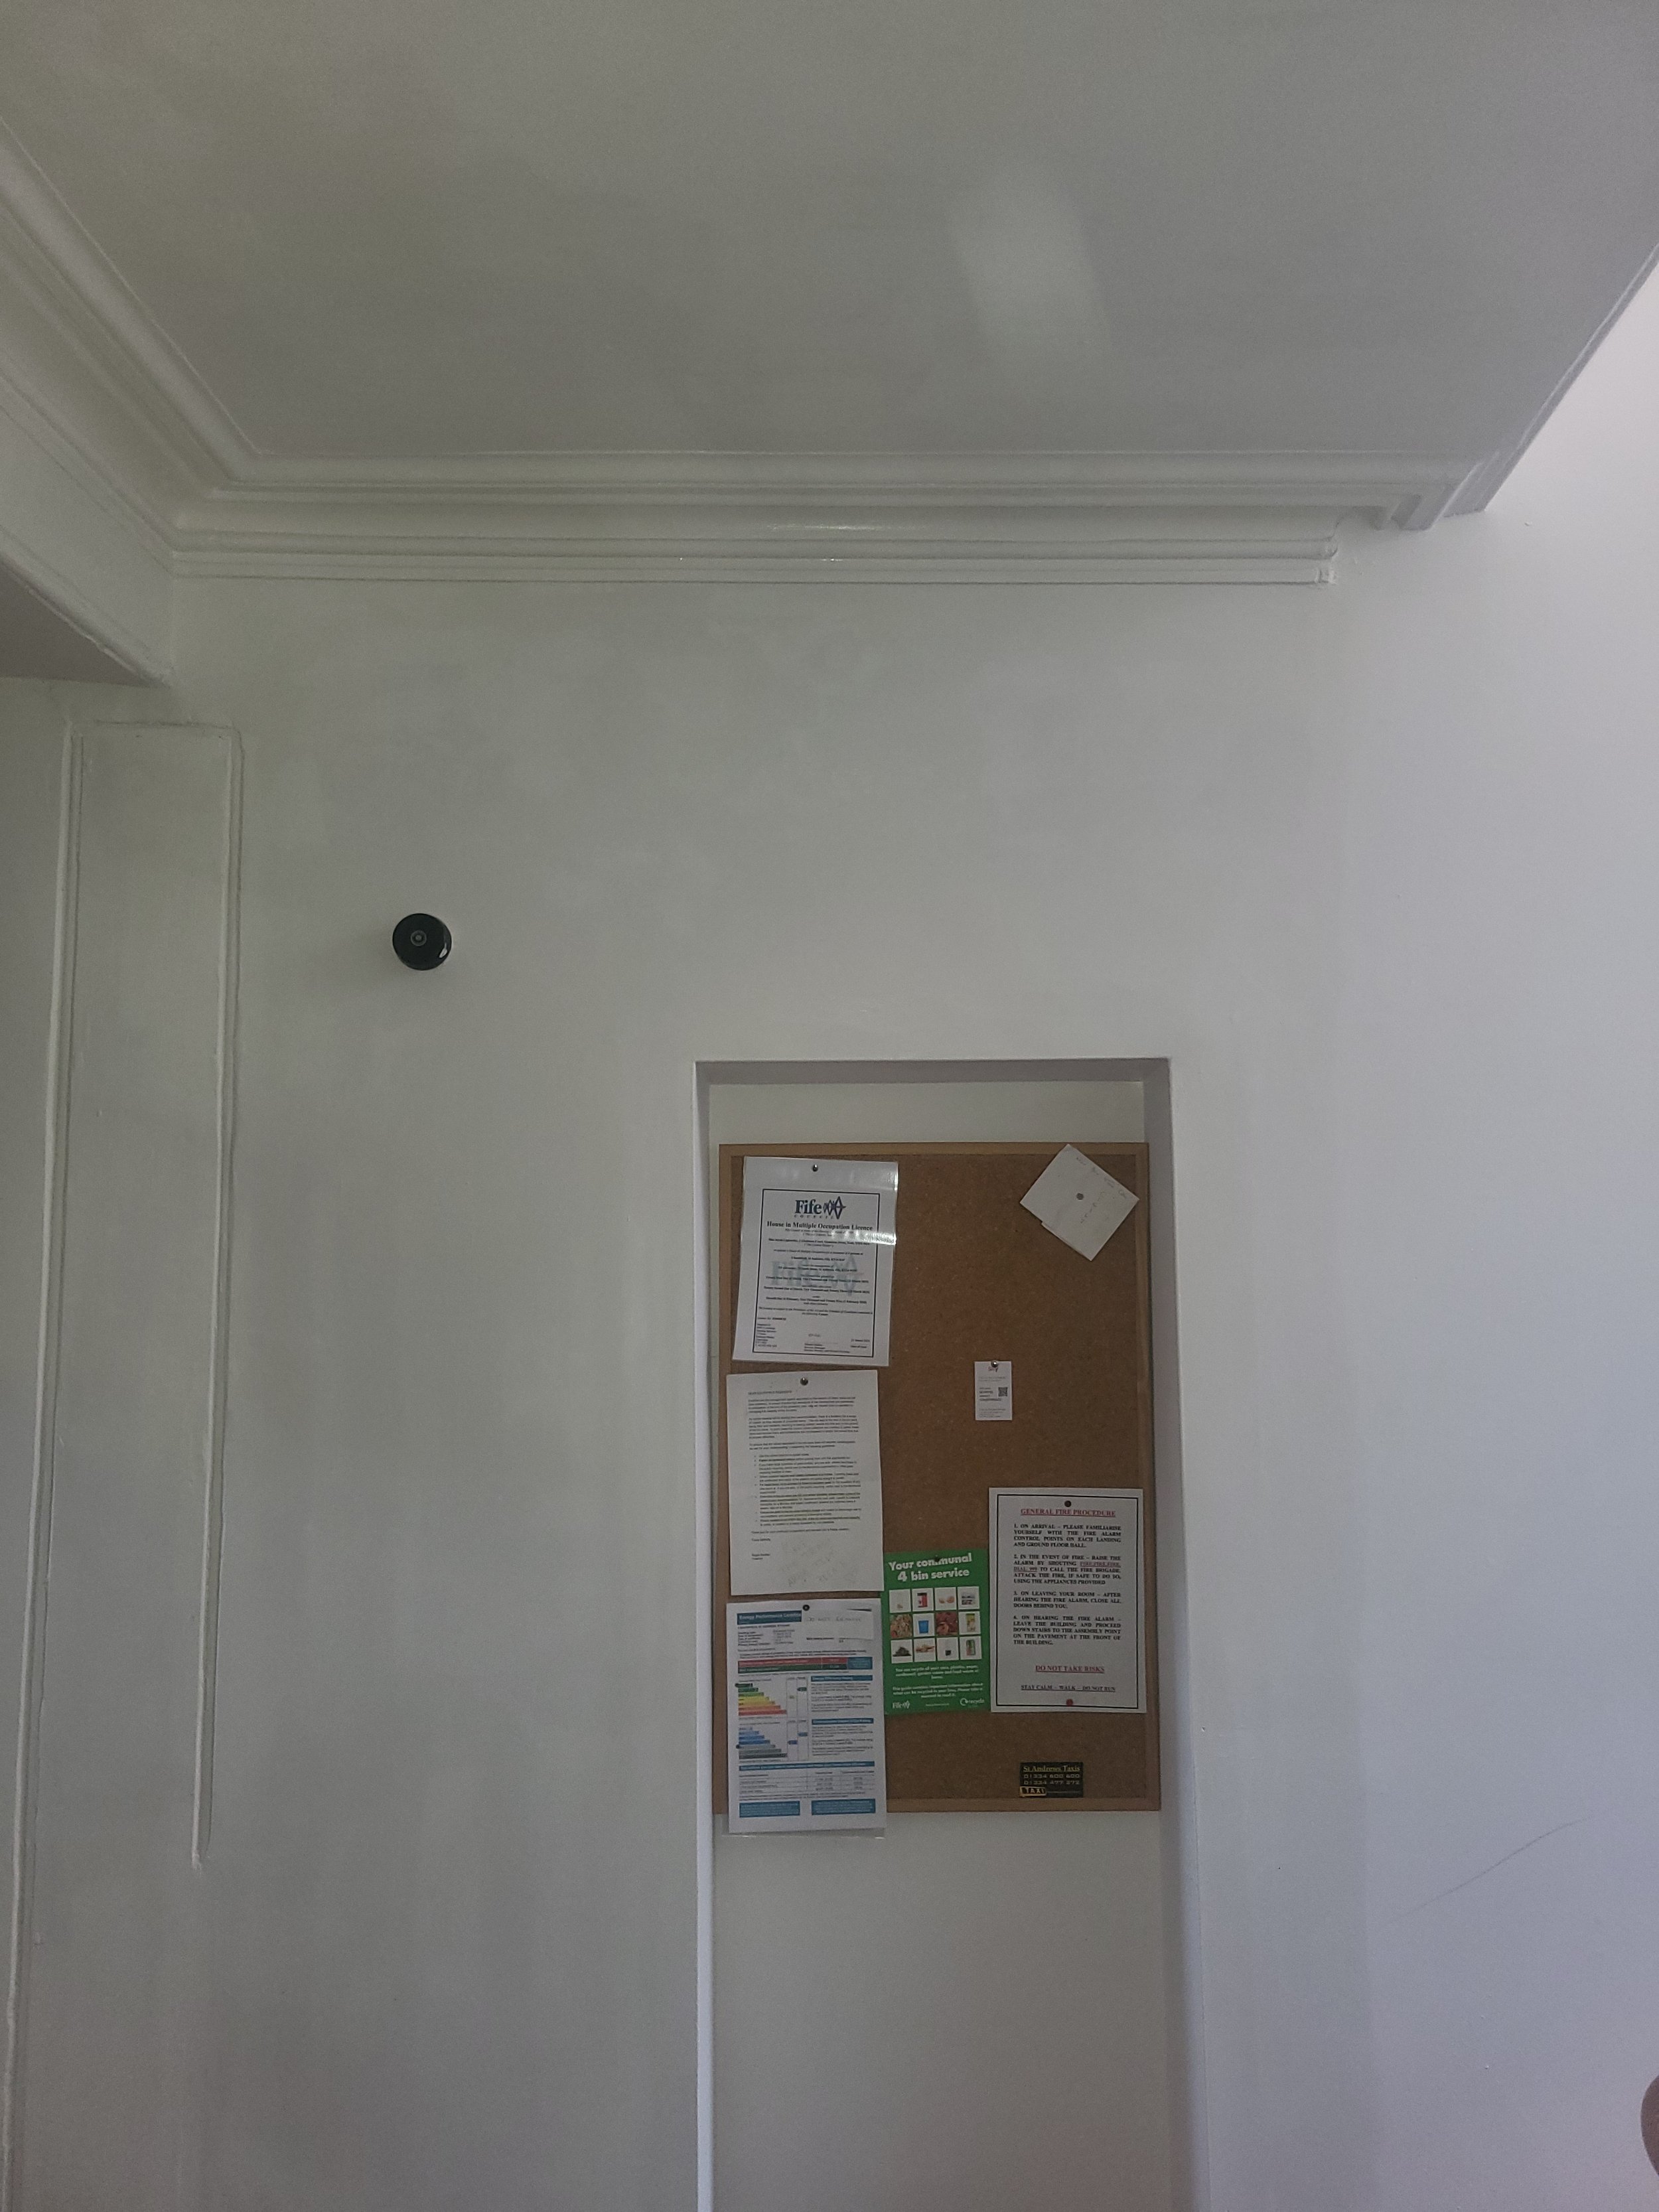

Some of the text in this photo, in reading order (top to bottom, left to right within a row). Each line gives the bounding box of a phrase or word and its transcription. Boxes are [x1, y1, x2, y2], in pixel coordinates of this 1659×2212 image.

[795, 1199, 822, 1214] Fife
[889, 1552, 972, 1571] Your communal
[898, 1568, 970, 1582] 4 bin service
